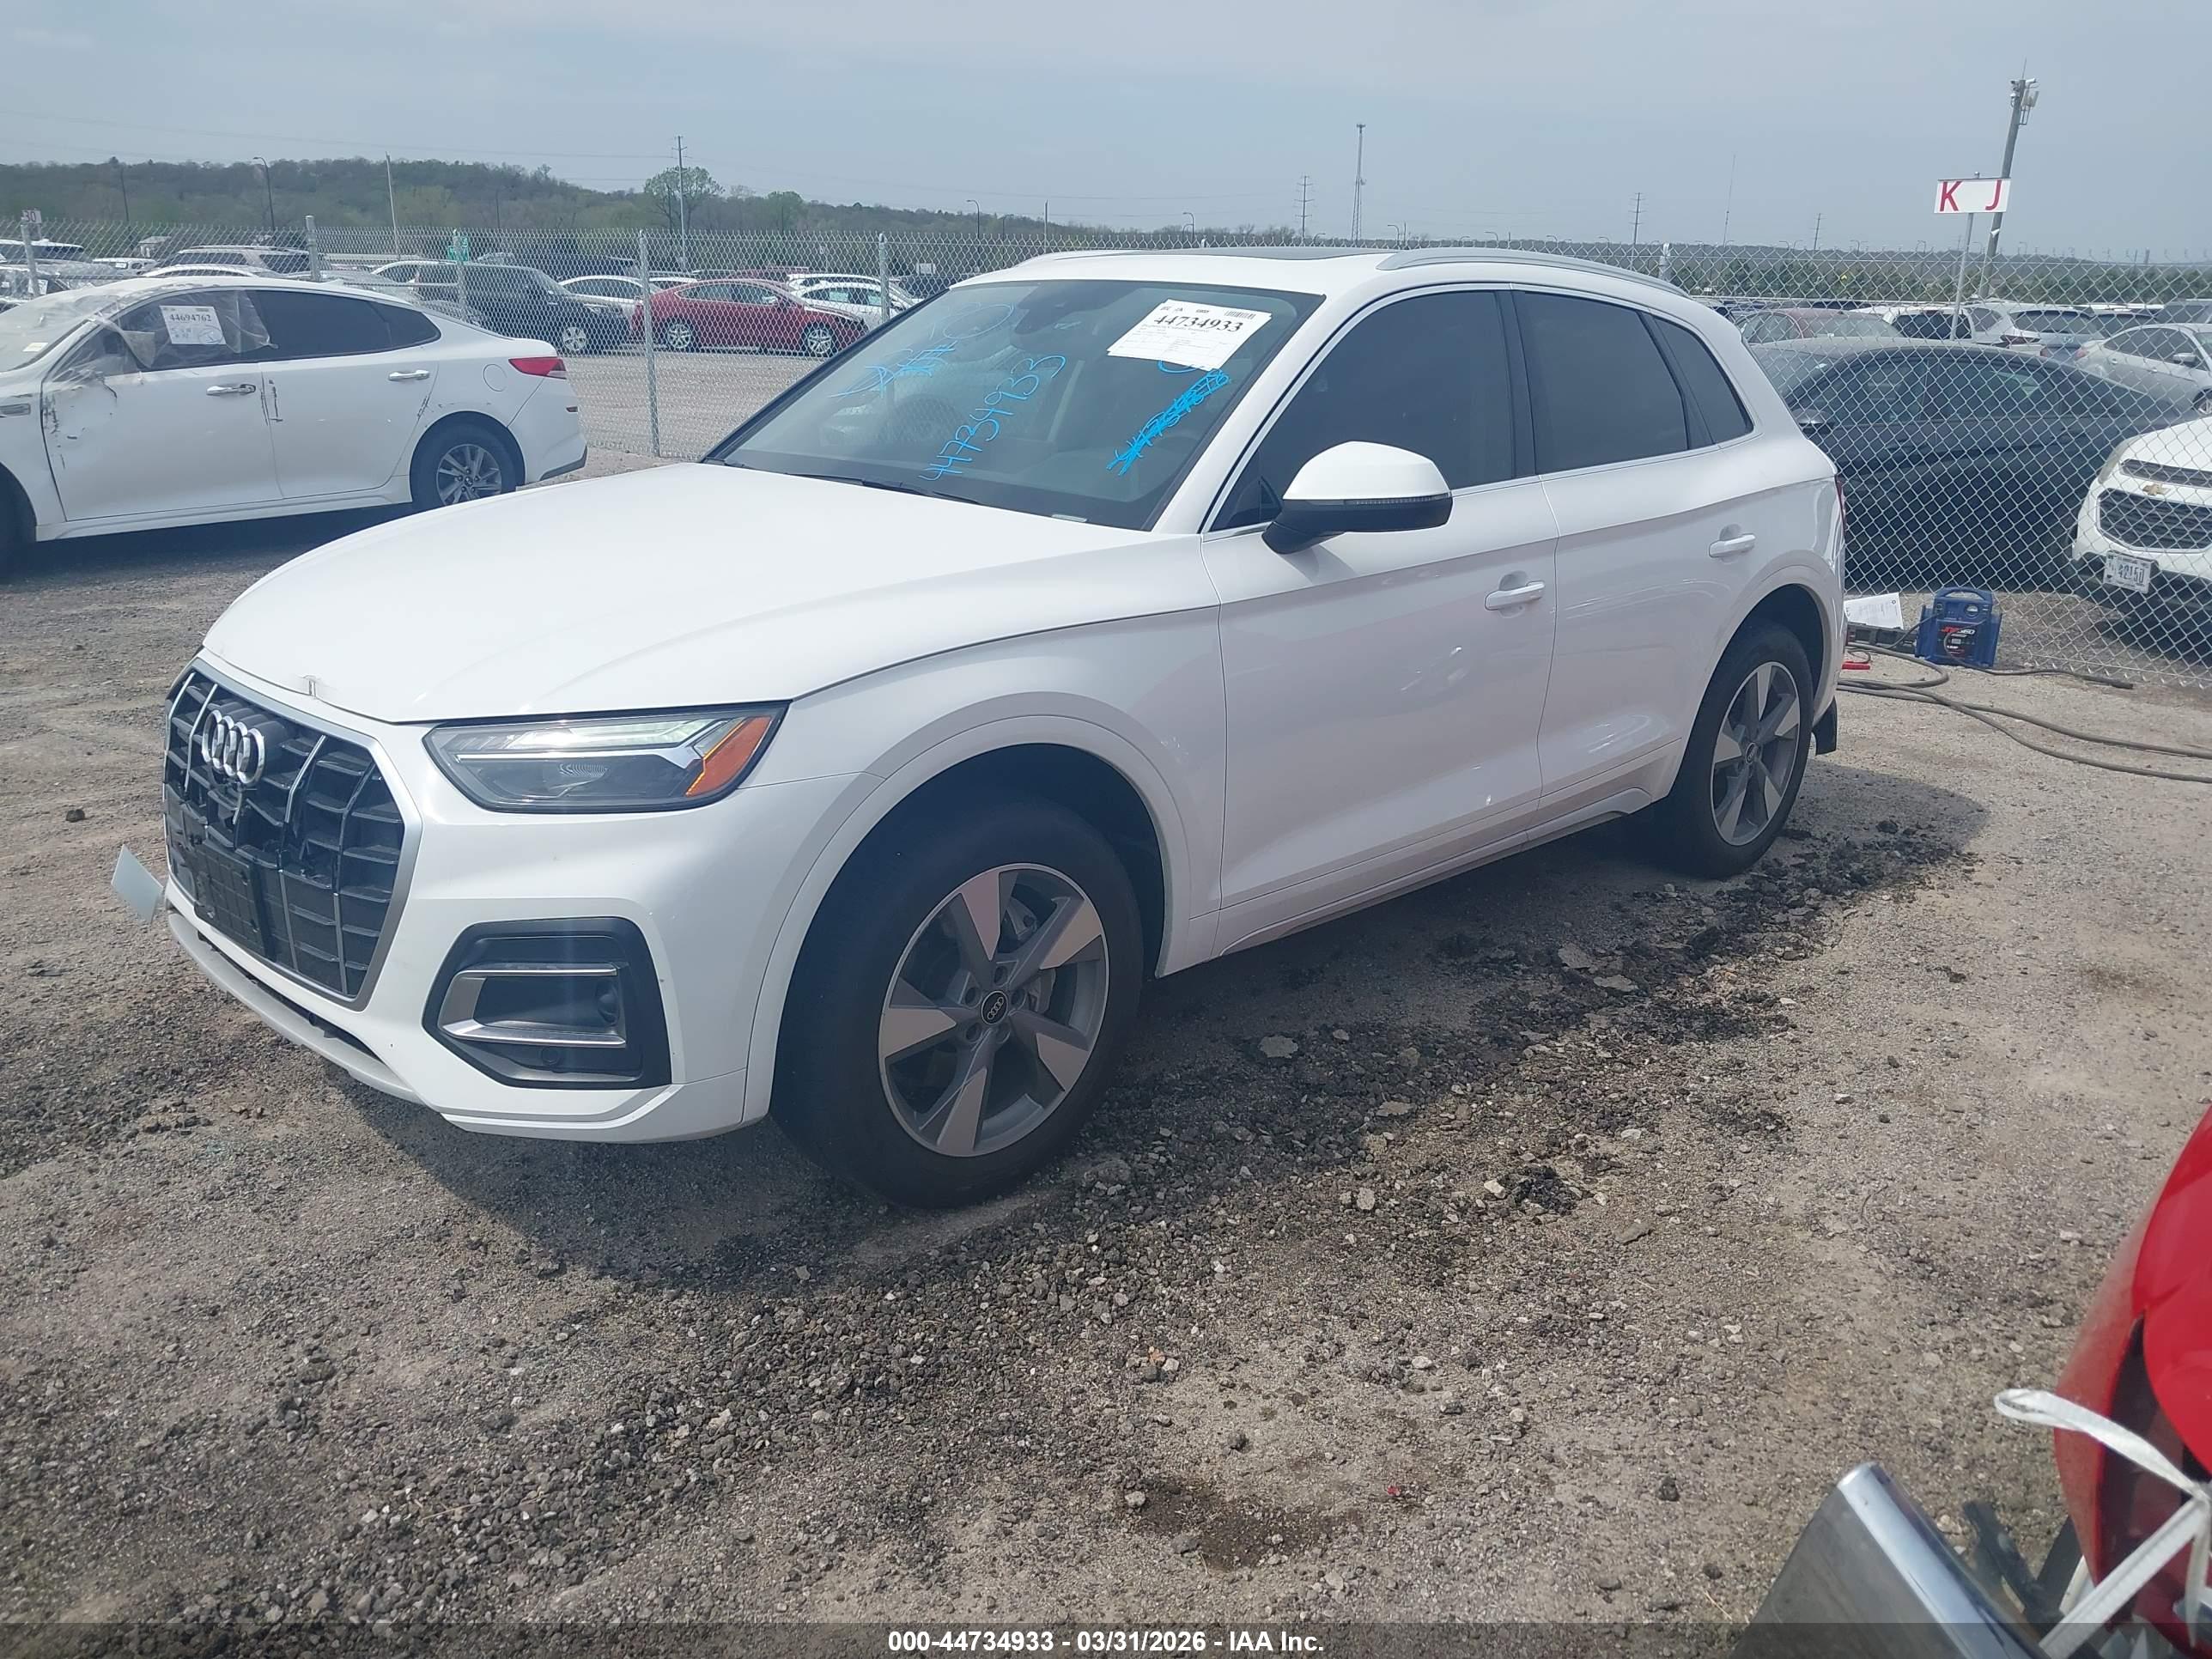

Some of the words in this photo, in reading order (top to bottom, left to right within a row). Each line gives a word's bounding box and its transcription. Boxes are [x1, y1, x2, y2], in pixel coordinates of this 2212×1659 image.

[1939, 180, 1964, 212] K
[1984, 179, 2002, 211] J
[1153, 314, 1244, 333] 44734933
[918, 354, 1066, 481] 44734933
